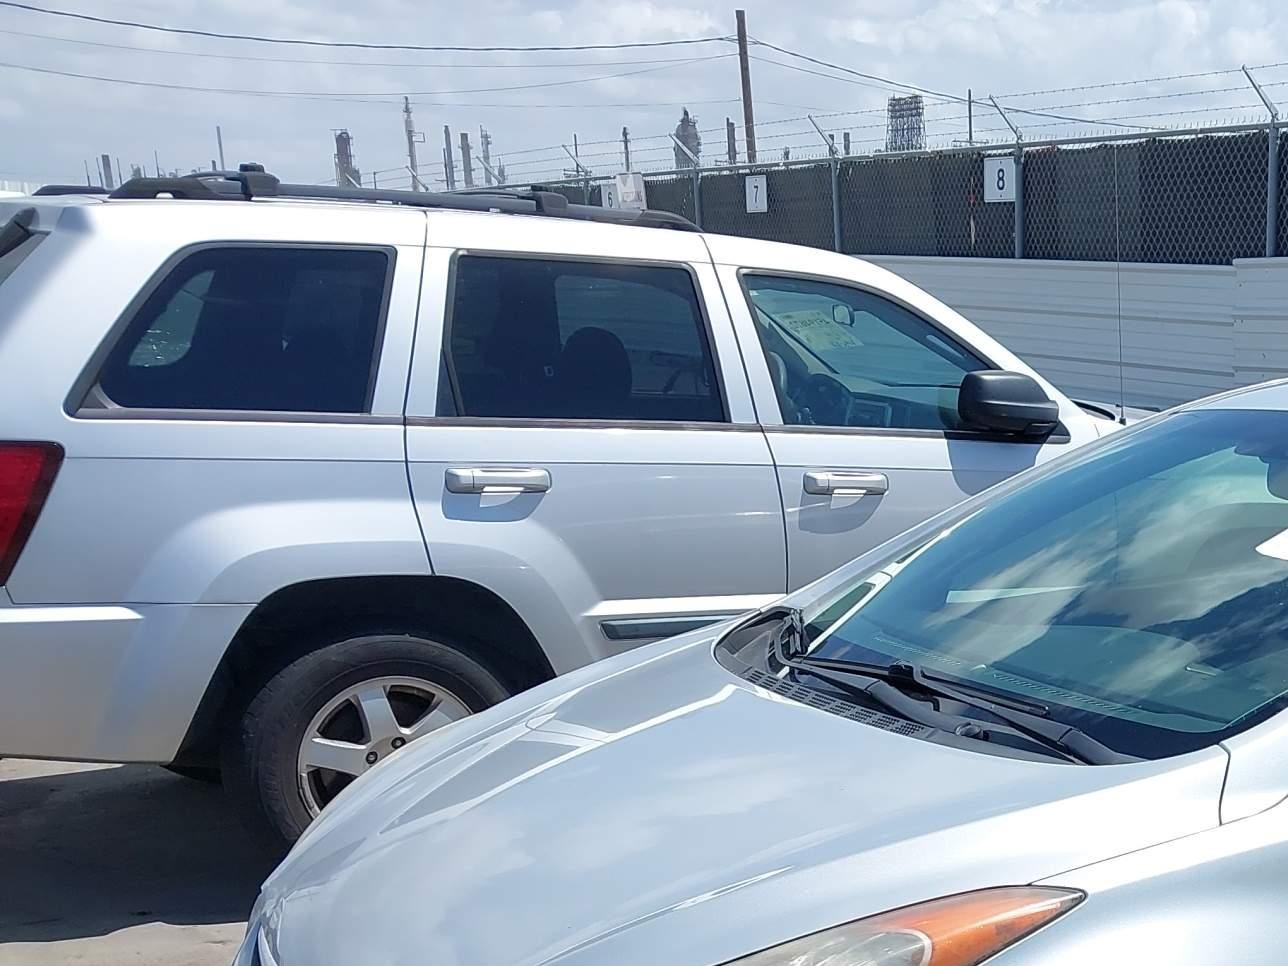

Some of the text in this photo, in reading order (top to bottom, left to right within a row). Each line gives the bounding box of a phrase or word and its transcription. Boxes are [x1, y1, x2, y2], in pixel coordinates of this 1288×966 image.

[996, 168, 1005, 191] 8
[607, 191, 613, 209] 6
[753, 185, 759, 203] 7
